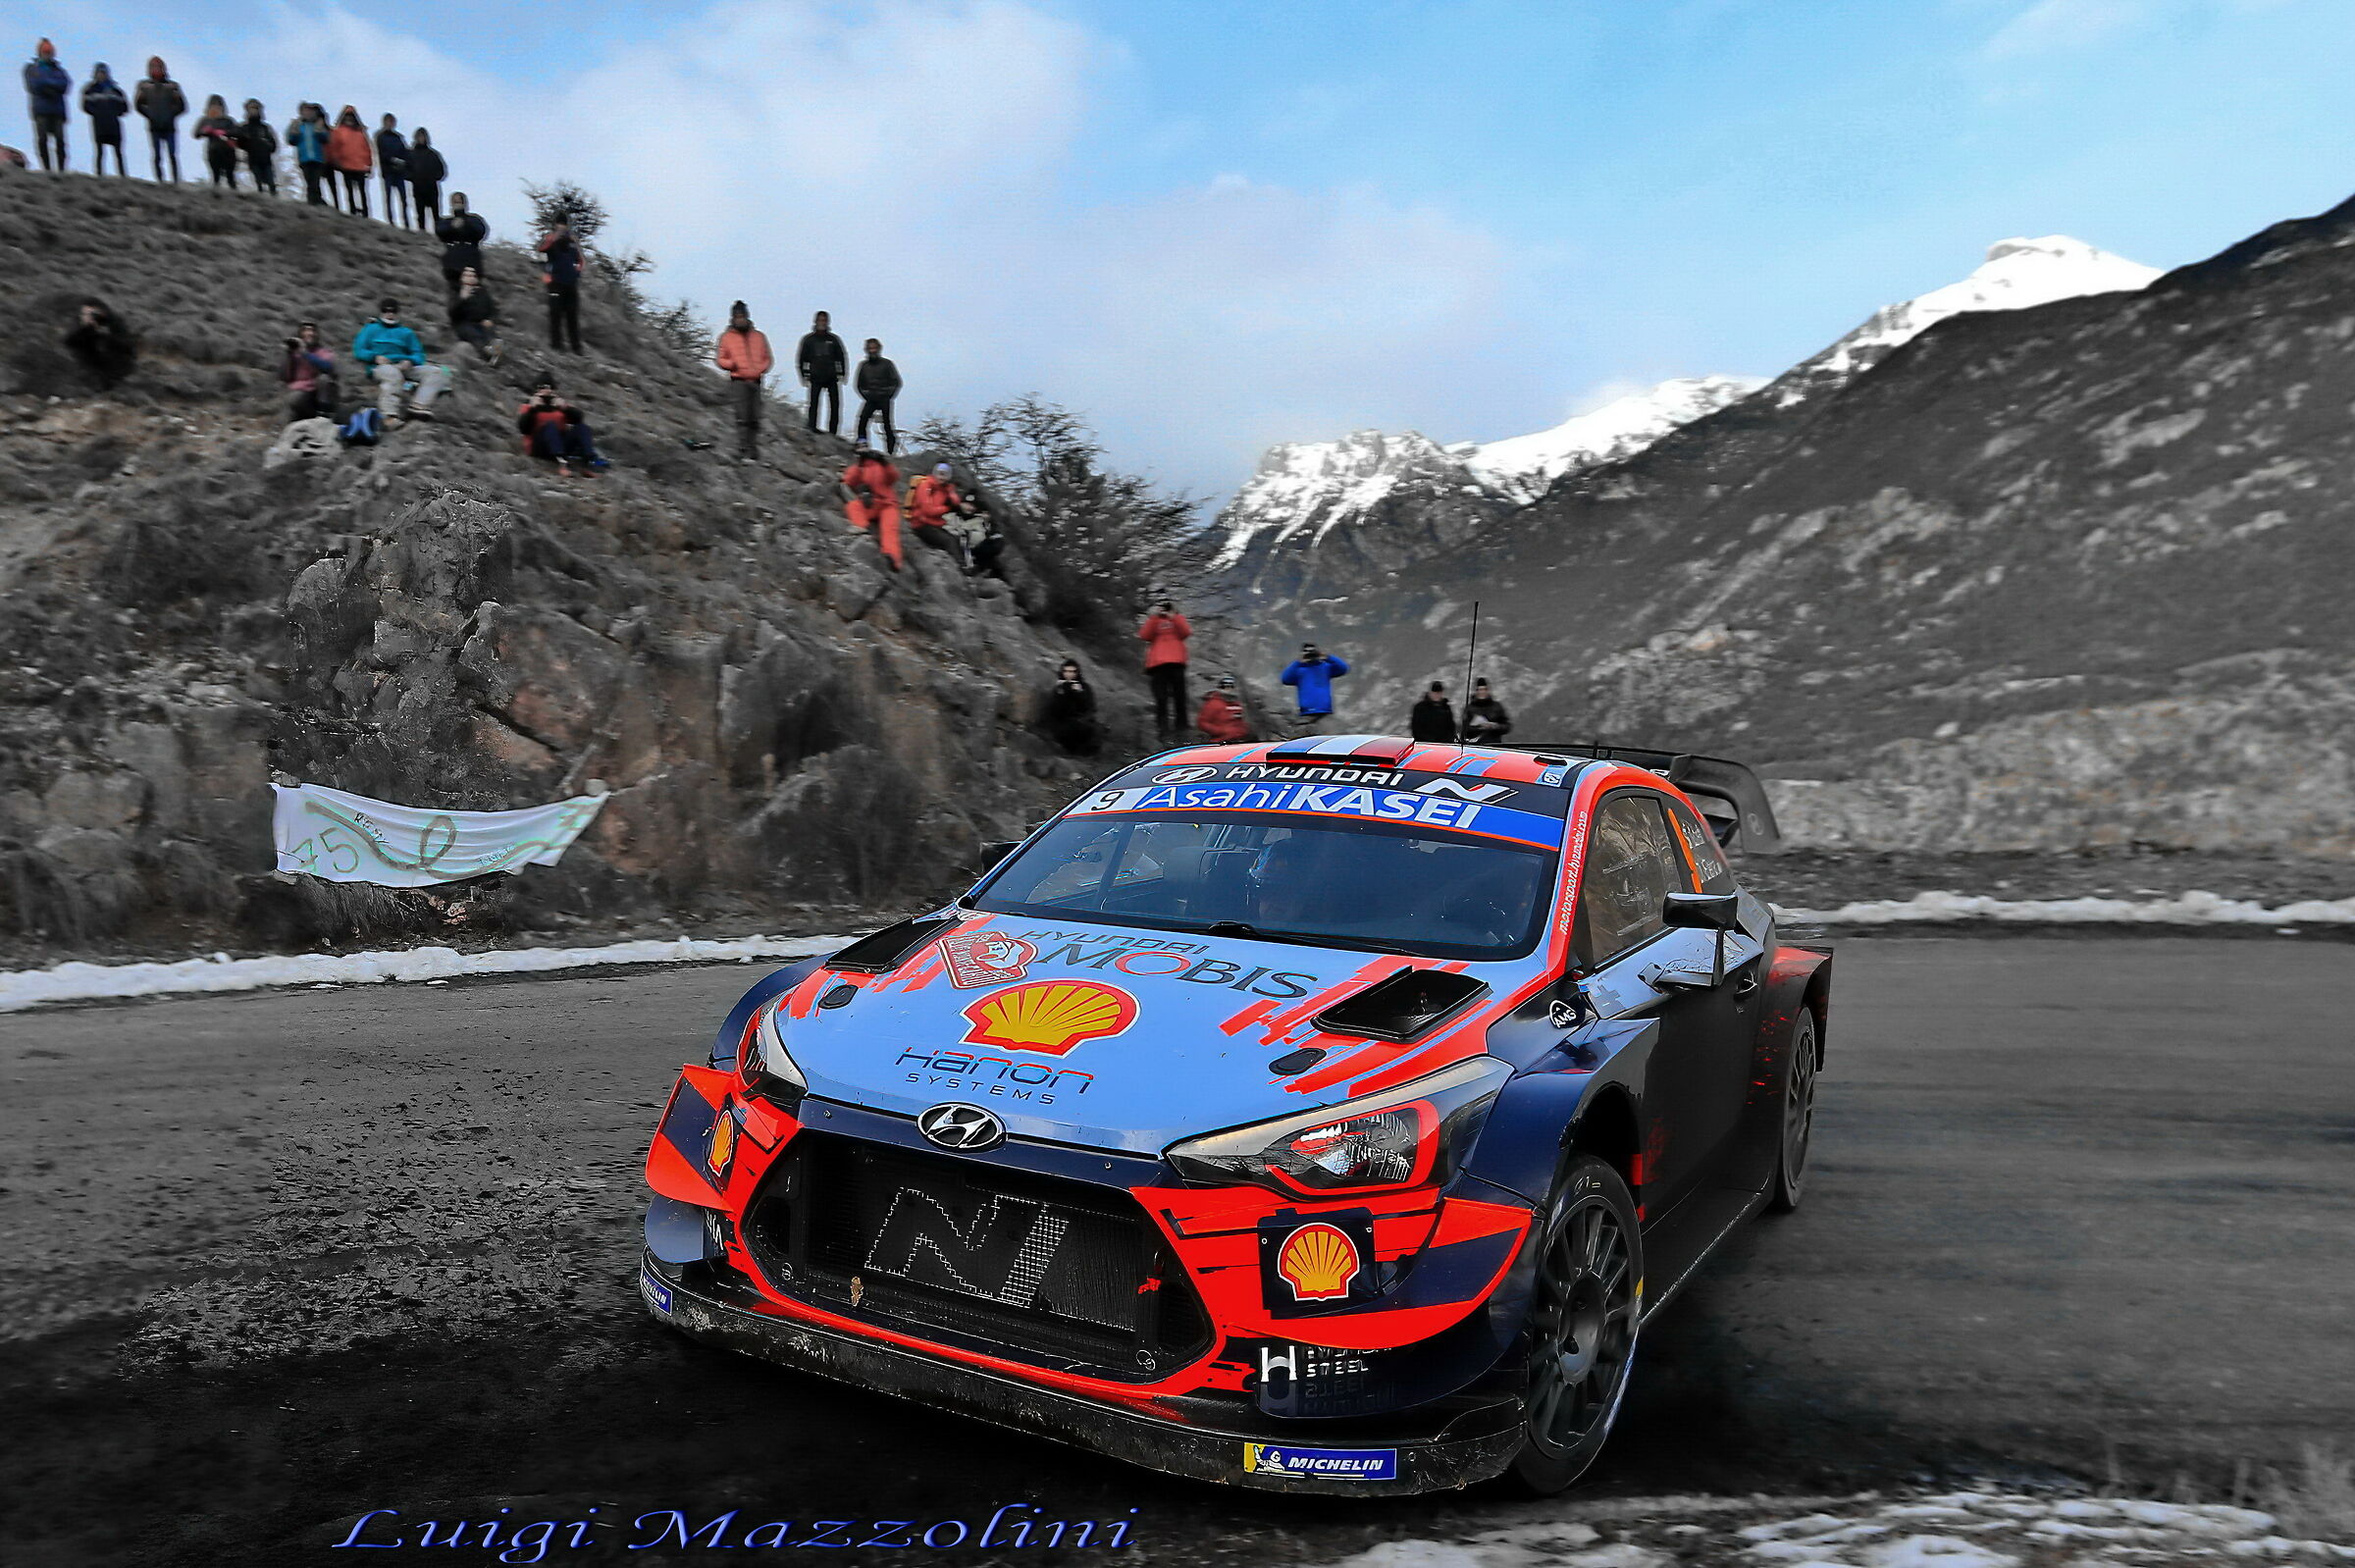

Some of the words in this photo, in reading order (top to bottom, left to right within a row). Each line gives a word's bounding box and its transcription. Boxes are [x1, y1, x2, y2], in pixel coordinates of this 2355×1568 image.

[1226, 765, 1405, 787] HYUNDAI
[1090, 790, 1125, 811] 9
[1137, 783, 1483, 829] AsahiKASEI
[1018, 930, 1212, 955] HYUNDAI
[1035, 943, 1319, 999] MOBIS
[905, 1072, 1057, 1105] SYSTEMS
[1305, 1359, 1370, 1378] STEEL
[1287, 1456, 1385, 1471] MICHELIN
